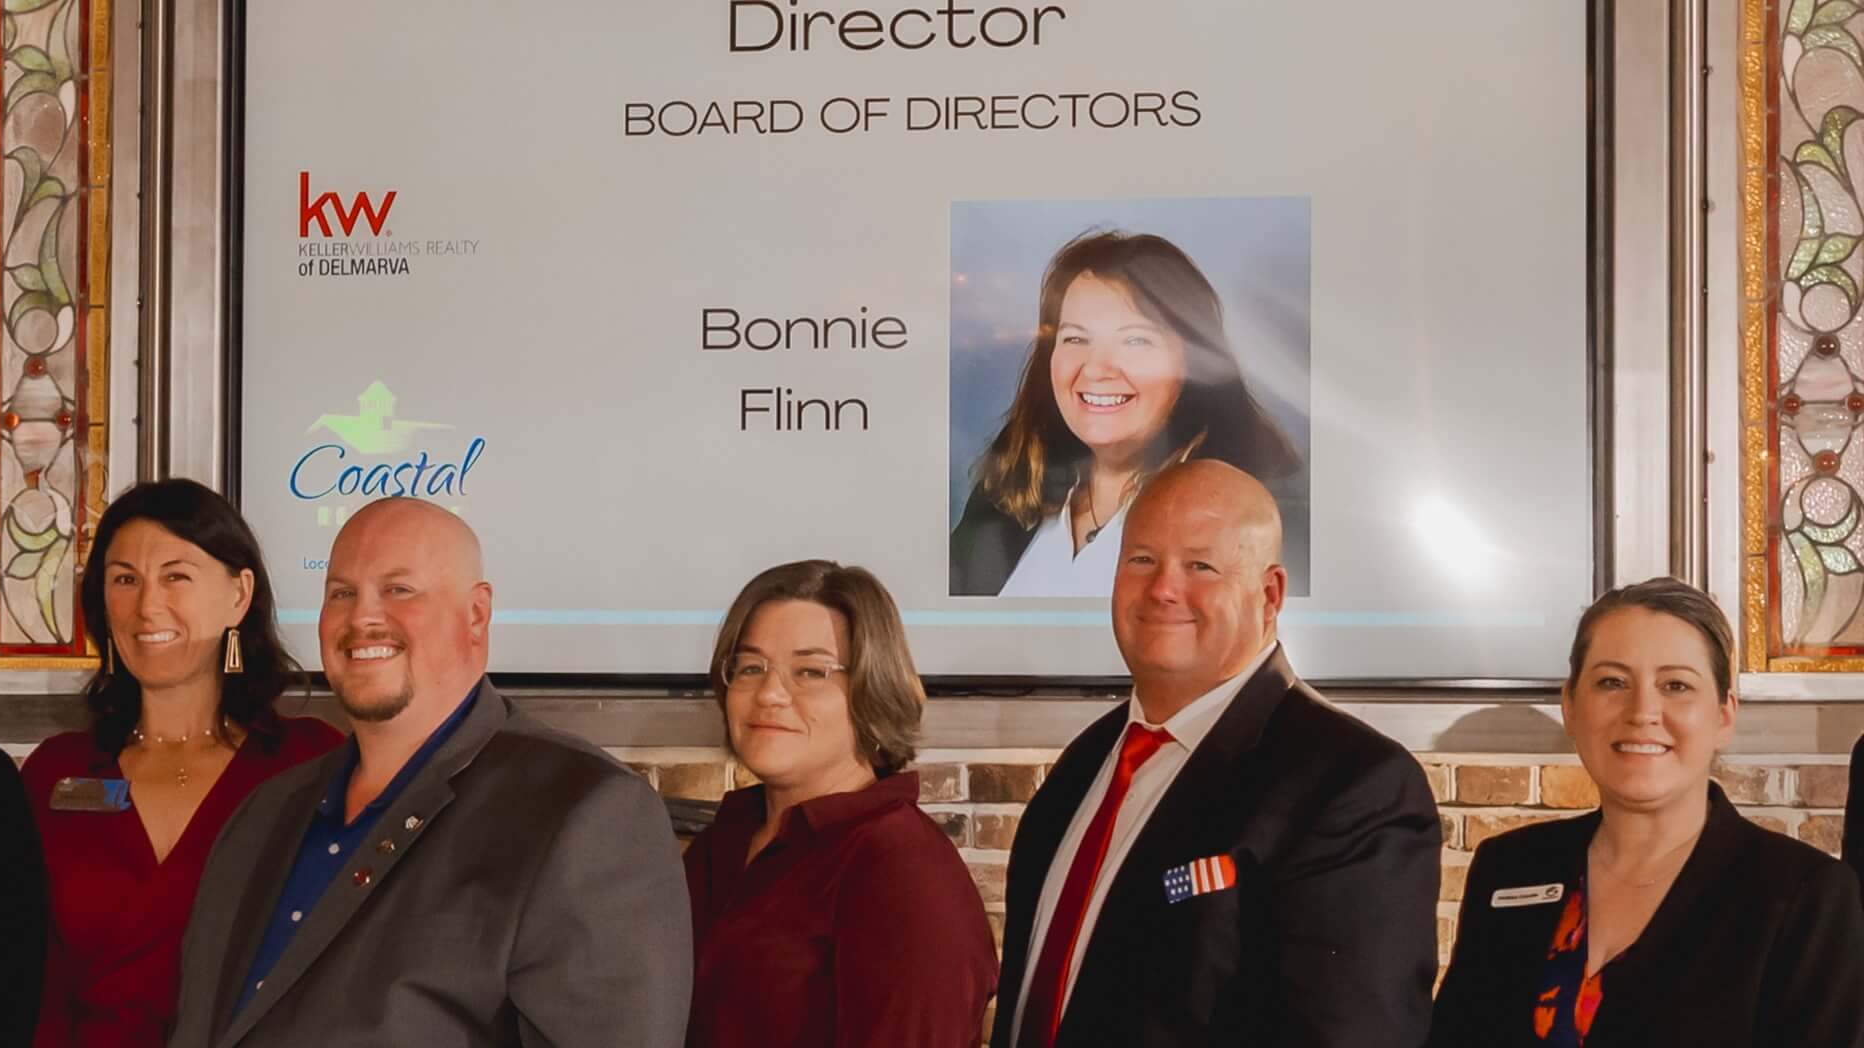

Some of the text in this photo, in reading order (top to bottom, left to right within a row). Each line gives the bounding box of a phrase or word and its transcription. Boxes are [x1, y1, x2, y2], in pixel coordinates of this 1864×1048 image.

[729, 0, 1067, 53] Director
[624, 90, 1202, 137] BOARD OF DIRECTORS
[298, 257, 411, 276] of DELMARVA
[426, 239, 480, 256] REALTY
[702, 306, 909, 351] Bonnie
[741, 386, 869, 431] Flinn
[289, 437, 487, 500] Coastal
